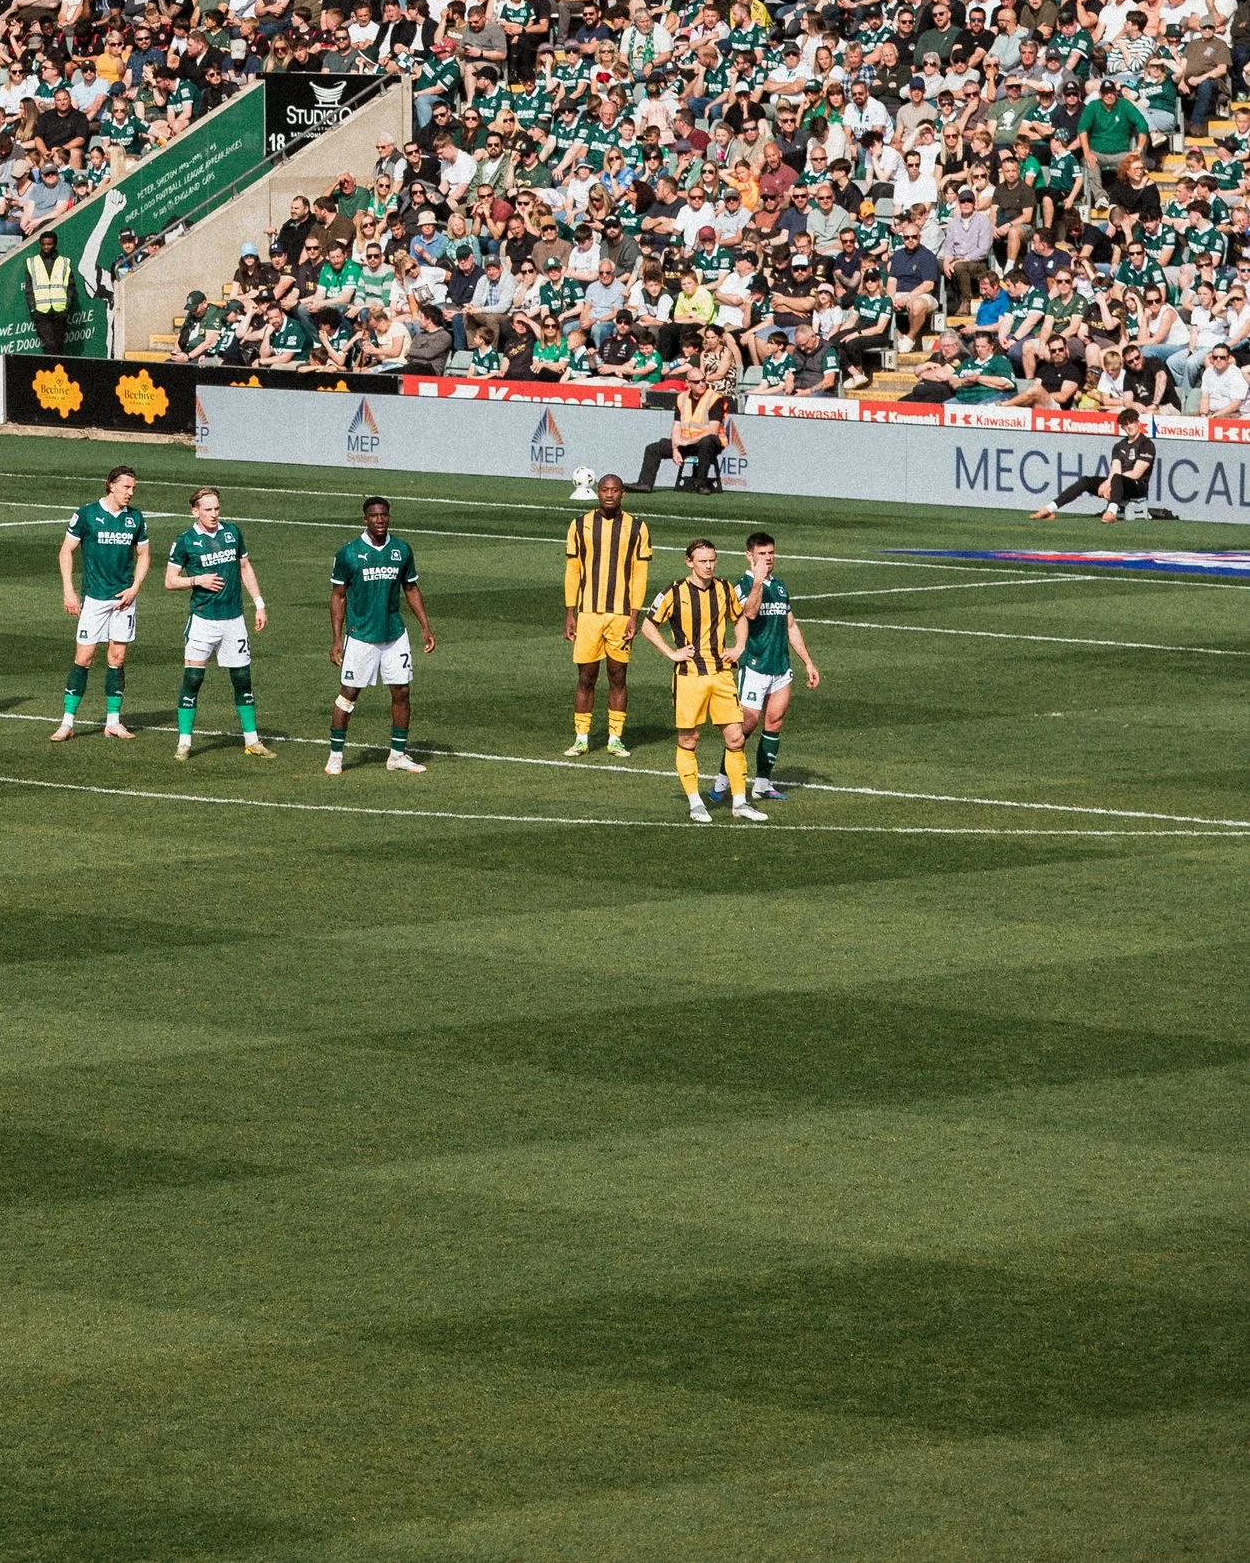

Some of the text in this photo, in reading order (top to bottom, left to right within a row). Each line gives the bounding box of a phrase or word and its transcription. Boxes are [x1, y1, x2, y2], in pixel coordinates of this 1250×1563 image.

[268, 133, 286, 151] 18
[137, 185, 157, 200] PETER
[156, 167, 178, 188] SHILTON
[155, 180, 182, 202] FOOTBALL
[183, 164, 205, 184] LEAGUE
[174, 182, 201, 205] ENGLAND
[202, 171, 216, 186] CAPS
[0, 324, 14, 337] WE
[0, 341, 15, 354] WE
[40, 384, 70, 396] Beehive
[124, 389, 155, 401] Beehive
[976, 414, 1026, 429] Kawasaki
[1062, 418, 1115, 435] Kawasaki
[347, 435, 380, 453] MEP
[346, 453, 380, 465] Systems
[530, 446, 566, 464] MEP
[955, 446, 1250, 509] MECHAICAL
[97, 532, 134, 540] BEACON
[200, 548, 236, 561] BEACON
[362, 566, 399, 575] BEACON
